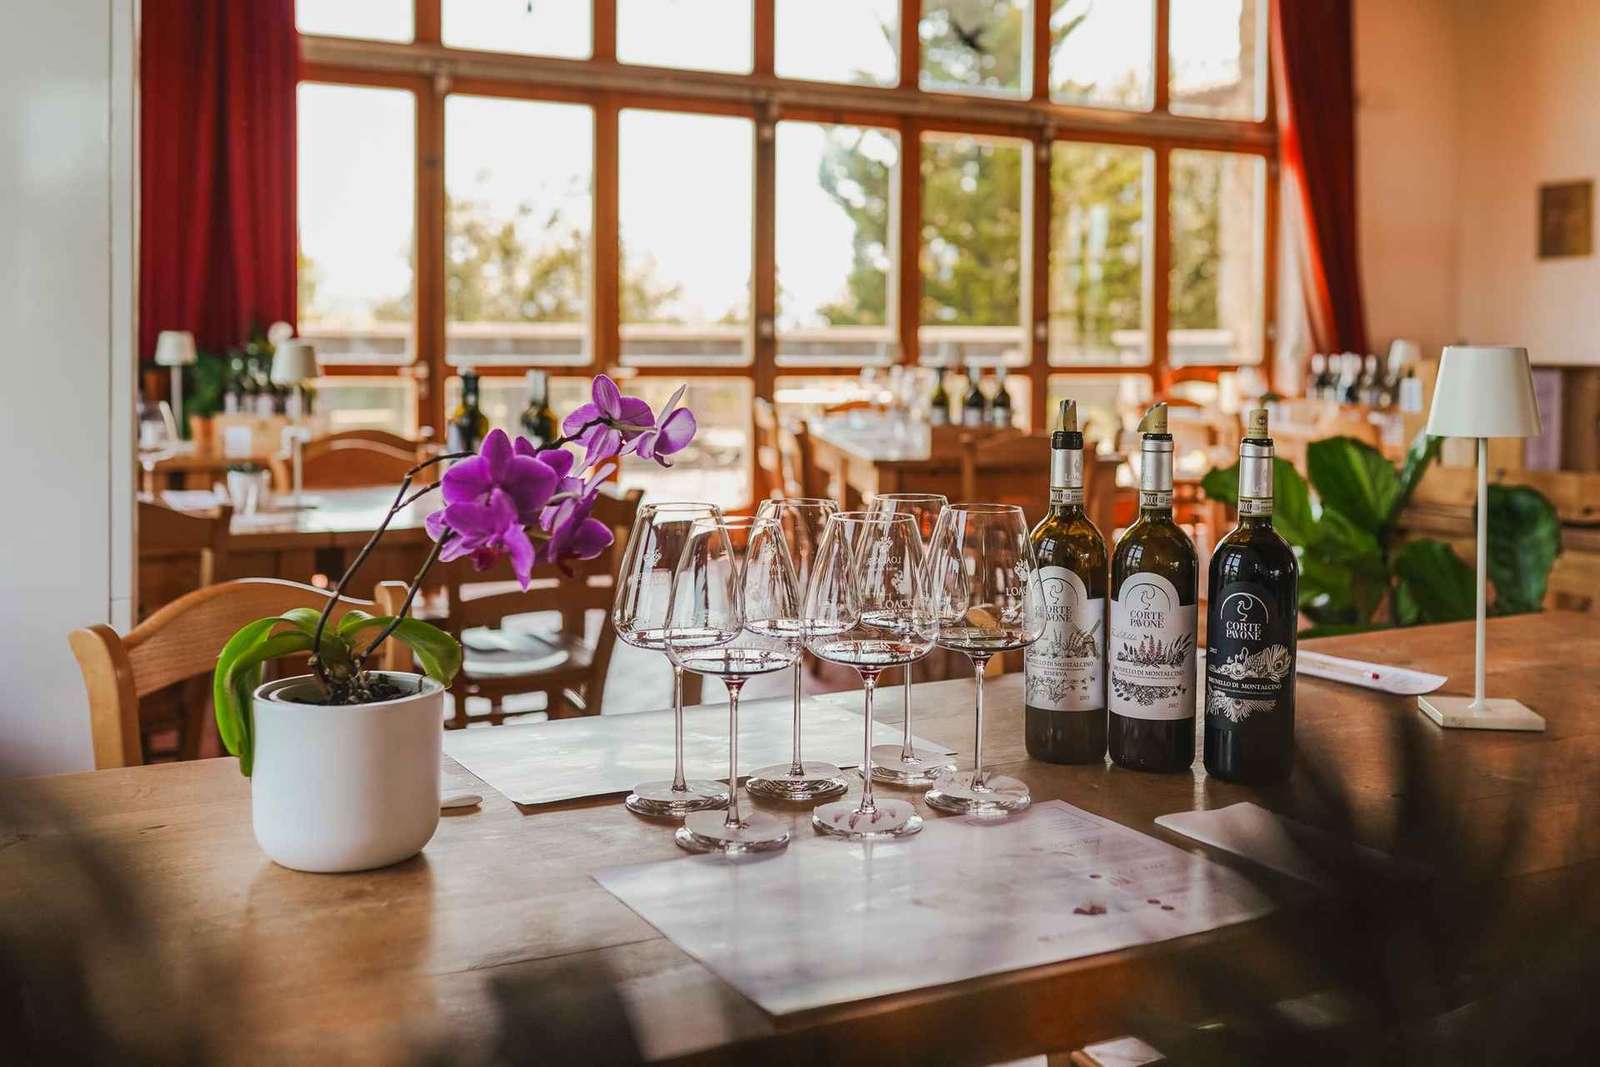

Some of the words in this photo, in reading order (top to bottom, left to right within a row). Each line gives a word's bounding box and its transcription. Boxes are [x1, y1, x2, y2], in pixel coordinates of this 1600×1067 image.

[880, 599, 914, 609] LOACK
[1035, 605, 1073, 615] ORTE
[1129, 609, 1165, 621] CORTE
[1035, 613, 1073, 623] VONE
[1130, 618, 1165, 630] PAVONE
[1226, 621, 1261, 633] CORTE
[1226, 630, 1261, 641] PAVONE
[1113, 665, 1137, 675] NELLO
[1145, 669, 1184, 677] MONTALCINO
[1231, 681, 1238, 689] DI
